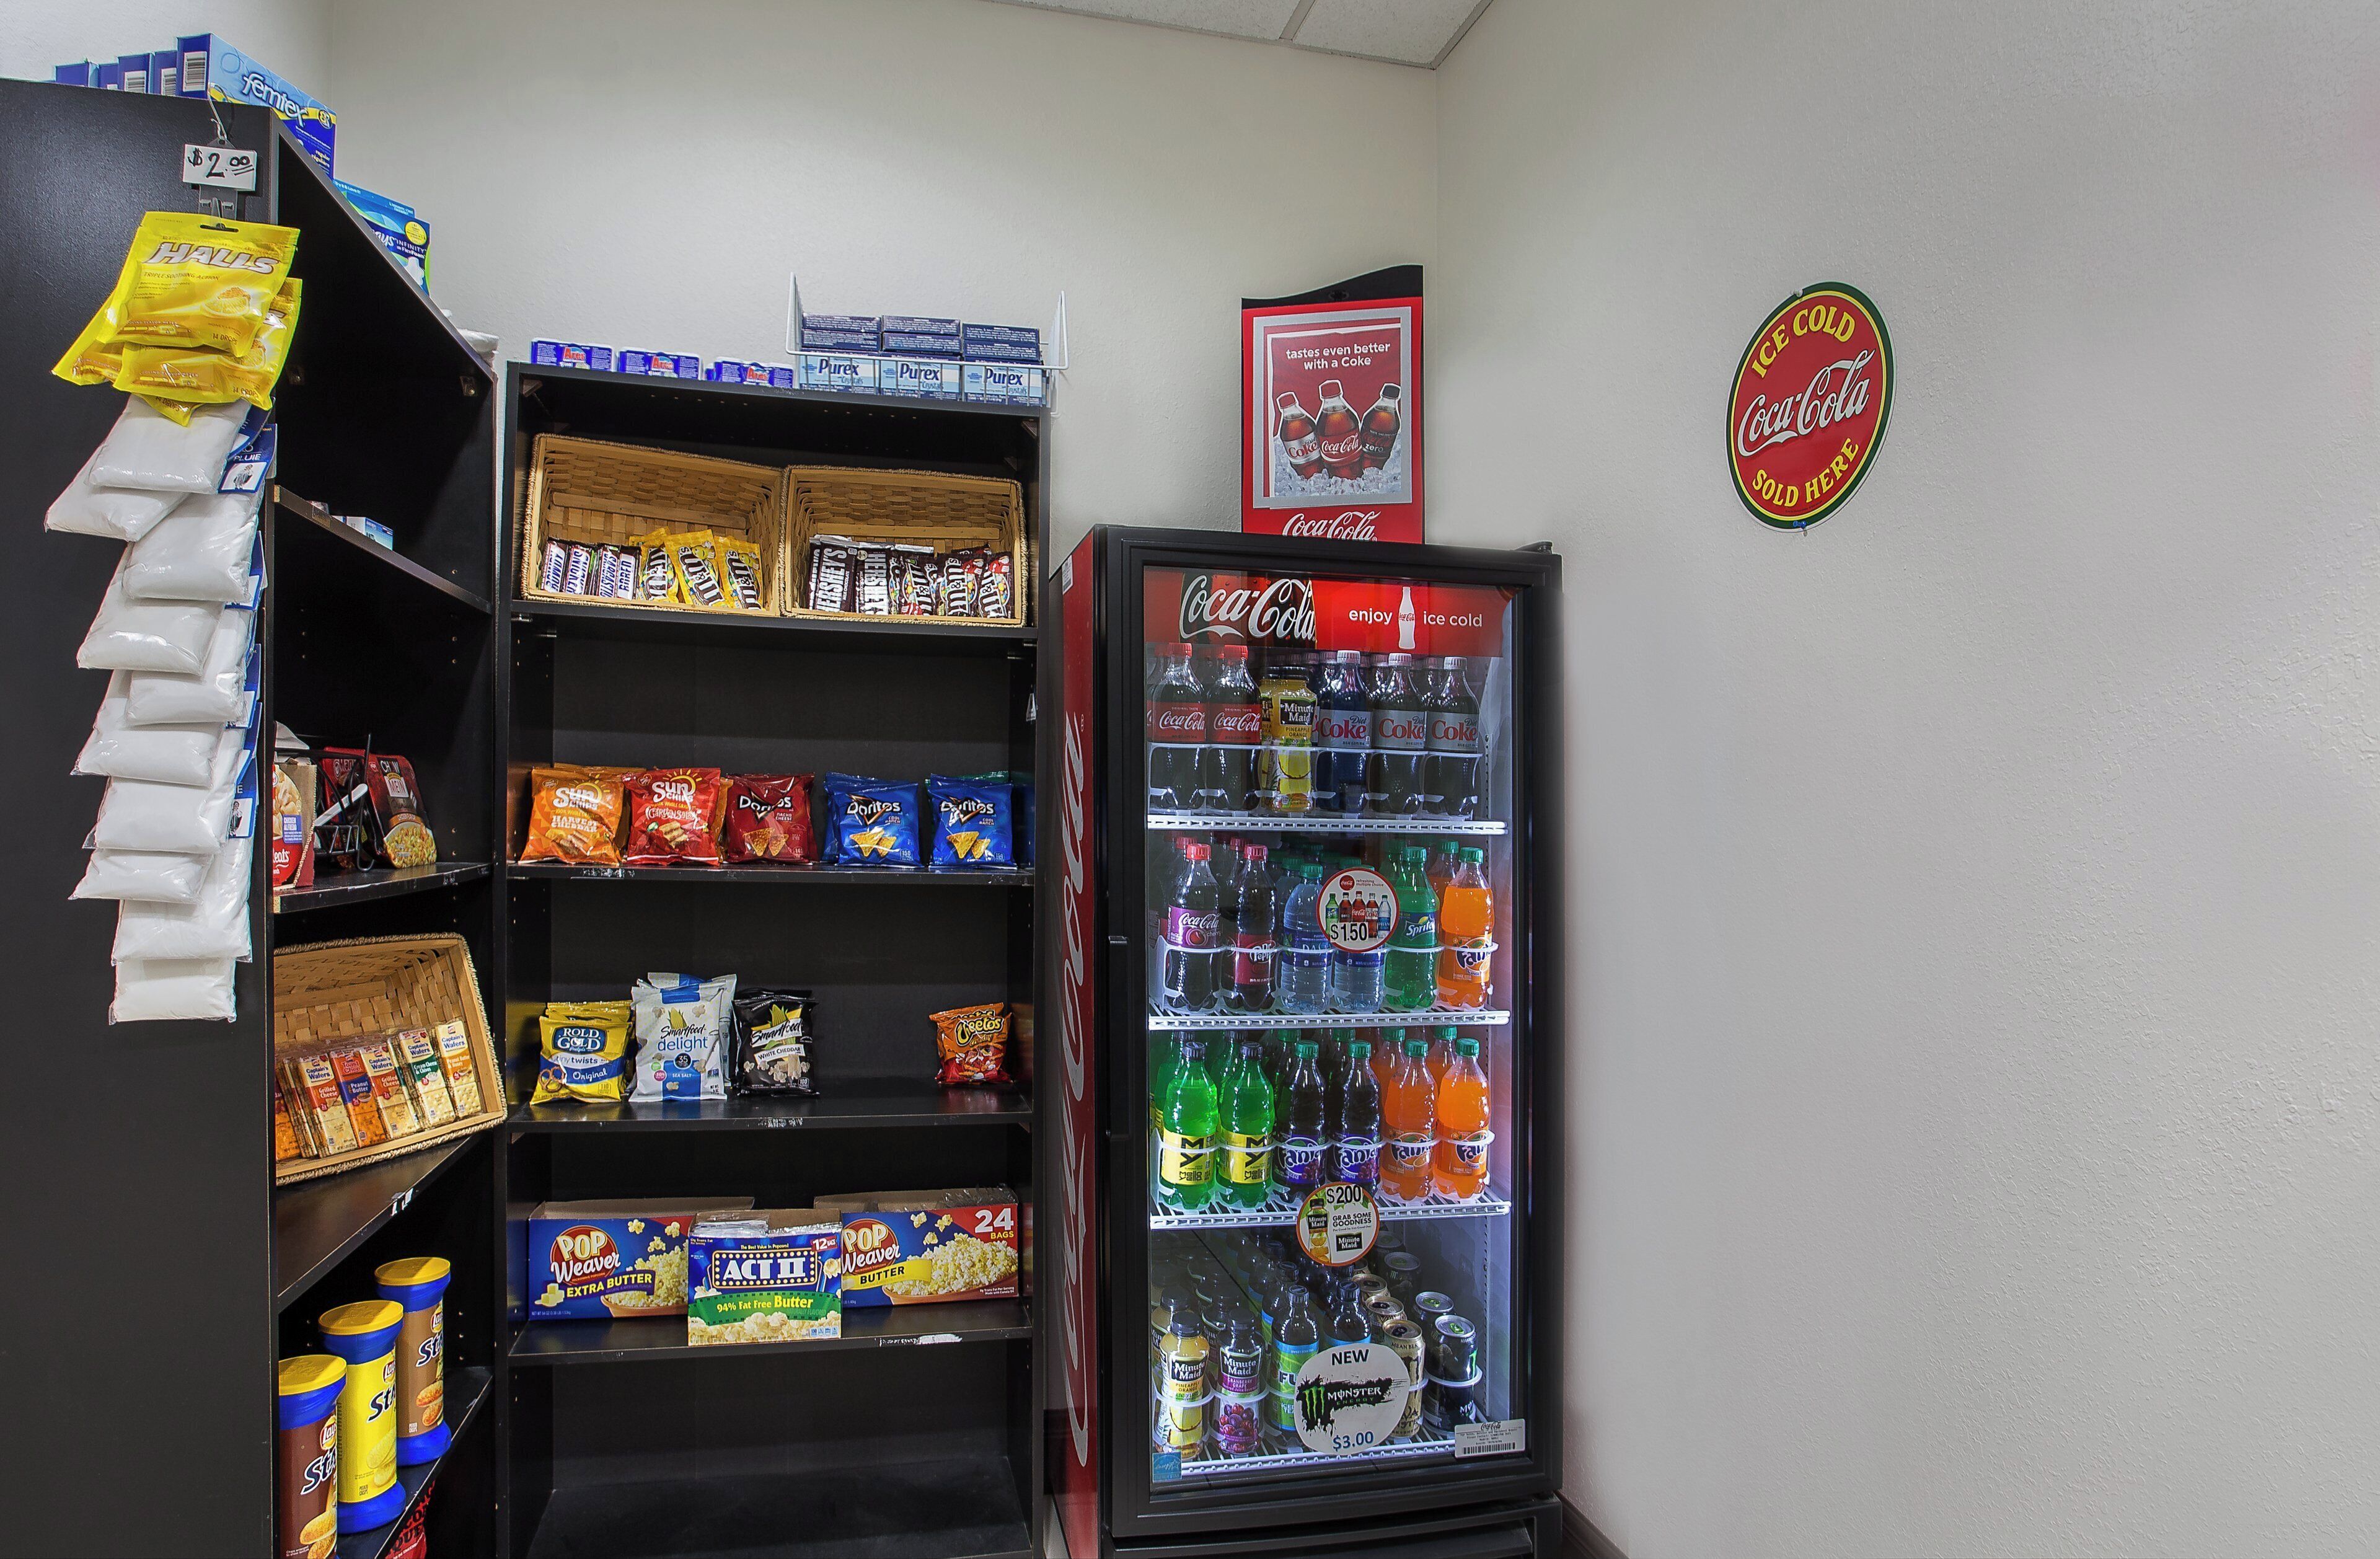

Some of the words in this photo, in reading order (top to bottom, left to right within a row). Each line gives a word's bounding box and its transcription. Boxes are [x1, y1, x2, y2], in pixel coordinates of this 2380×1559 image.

[242, 73, 307, 128] femtex
[397, 239, 425, 254] INFINITY
[142, 241, 281, 275] HALLS
[219, 333, 238, 345] DROPS
[1752, 324, 1789, 378] ICE
[1793, 304, 1856, 343] COLD
[564, 347, 586, 361] Ares
[1286, 345, 1320, 360] tastes
[1323, 346, 1351, 357] even
[1354, 342, 1391, 355] better
[651, 356, 674, 370] Ares
[819, 358, 860, 376] Purex
[1303, 357, 1329, 371] with
[1331, 359, 1339, 368] a
[1341, 356, 1372, 368] Coke
[900, 363, 940, 381] Purex
[985, 366, 1023, 386] Purex
[1737, 349, 1875, 457] Coca-Cola
[1288, 441, 1317, 457] Coke
[1321, 433, 1361, 454] Coca-Cola
[1365, 443, 1383, 453] zero
[234, 453, 262, 462] PLUIE
[1752, 469, 1799, 508] SOLD
[1805, 438, 1859, 503] HERE
[1282, 510, 1382, 541] Coca-Cola
[1179, 574, 1316, 641] Coca-Cola
[1348, 609, 1393, 625] enjoy
[1422, 611, 1445, 626] ice
[1448, 612, 1483, 627] cold
[1284, 702, 1314, 713] Minute
[1159, 711, 1206, 730] Coca-Cola
[1214, 712, 1261, 731] Coca-Cola
[1289, 712, 1311, 722] Maid
[1349, 715, 1367, 724] Diet
[1320, 718, 1367, 739] Coke
[1379, 718, 1424, 740] Coke
[1431, 719, 1478, 741] Coke
[388, 779, 408, 794] MEIN
[652, 781, 690, 803] Sun
[553, 787, 595, 808] Sun
[666, 793, 694, 802] CHIPS
[847, 800, 901, 815] Doritos
[940, 800, 994, 815] Doritos
[551, 822, 597, 832] CHEDDAR
[552, 815, 598, 826] HARVEST
[1178, 912, 1221, 929] Coca-Cola
[1406, 921, 1435, 937] Sprite
[441, 1034, 464, 1043] Captain's
[563, 1027, 600, 1038] ROLD
[660, 1023, 705, 1040] Smartfood
[750, 1018, 802, 1046] Smartfood
[956, 1017, 1003, 1046] Cheetos
[443, 1041, 465, 1049] Wafers
[557, 1036, 601, 1050] GOLD
[658, 1035, 708, 1053] delight
[557, 1055, 570, 1064] tiny
[678, 1055, 689, 1064] 35
[758, 1050, 776, 1060] WHITE
[308, 1072, 330, 1080] Wafers
[344, 1066, 361, 1074] Chee
[573, 1067, 607, 1082] Original
[1065, 714, 1086, 1468] Coca-Cola
[974, 1208, 1015, 1234] 24
[1333, 1217, 1372, 1227] GOODNESS
[842, 1223, 888, 1253] POP
[990, 1230, 1015, 1240] BAGS
[556, 1230, 608, 1261] POP
[813, 1238, 827, 1251] 12
[550, 1251, 622, 1283] Weaver
[842, 1243, 902, 1275] Weaver
[723, 1259, 774, 1280] ACT
[777, 1257, 806, 1279] II
[860, 1266, 905, 1285] BUTTER
[566, 1281, 604, 1297] EXTRA
[607, 1273, 653, 1288] BUTTER
[716, 1302, 736, 1313] 94%
[739, 1301, 751, 1310] Fat
[754, 1299, 772, 1309] Free
[774, 1295, 813, 1309] Butter
[1223, 1356, 1257, 1367] Minute
[1331, 1349, 1369, 1366] NEW
[1175, 1362, 1205, 1373] Minute
[1179, 1371, 1202, 1380] Maid
[1228, 1365, 1253, 1375] Maid
[1328, 1387, 1382, 1401] MONSTER
[1336, 1397, 1374, 1405] ENERGY
[1333, 1431, 1374, 1452] $3.00
